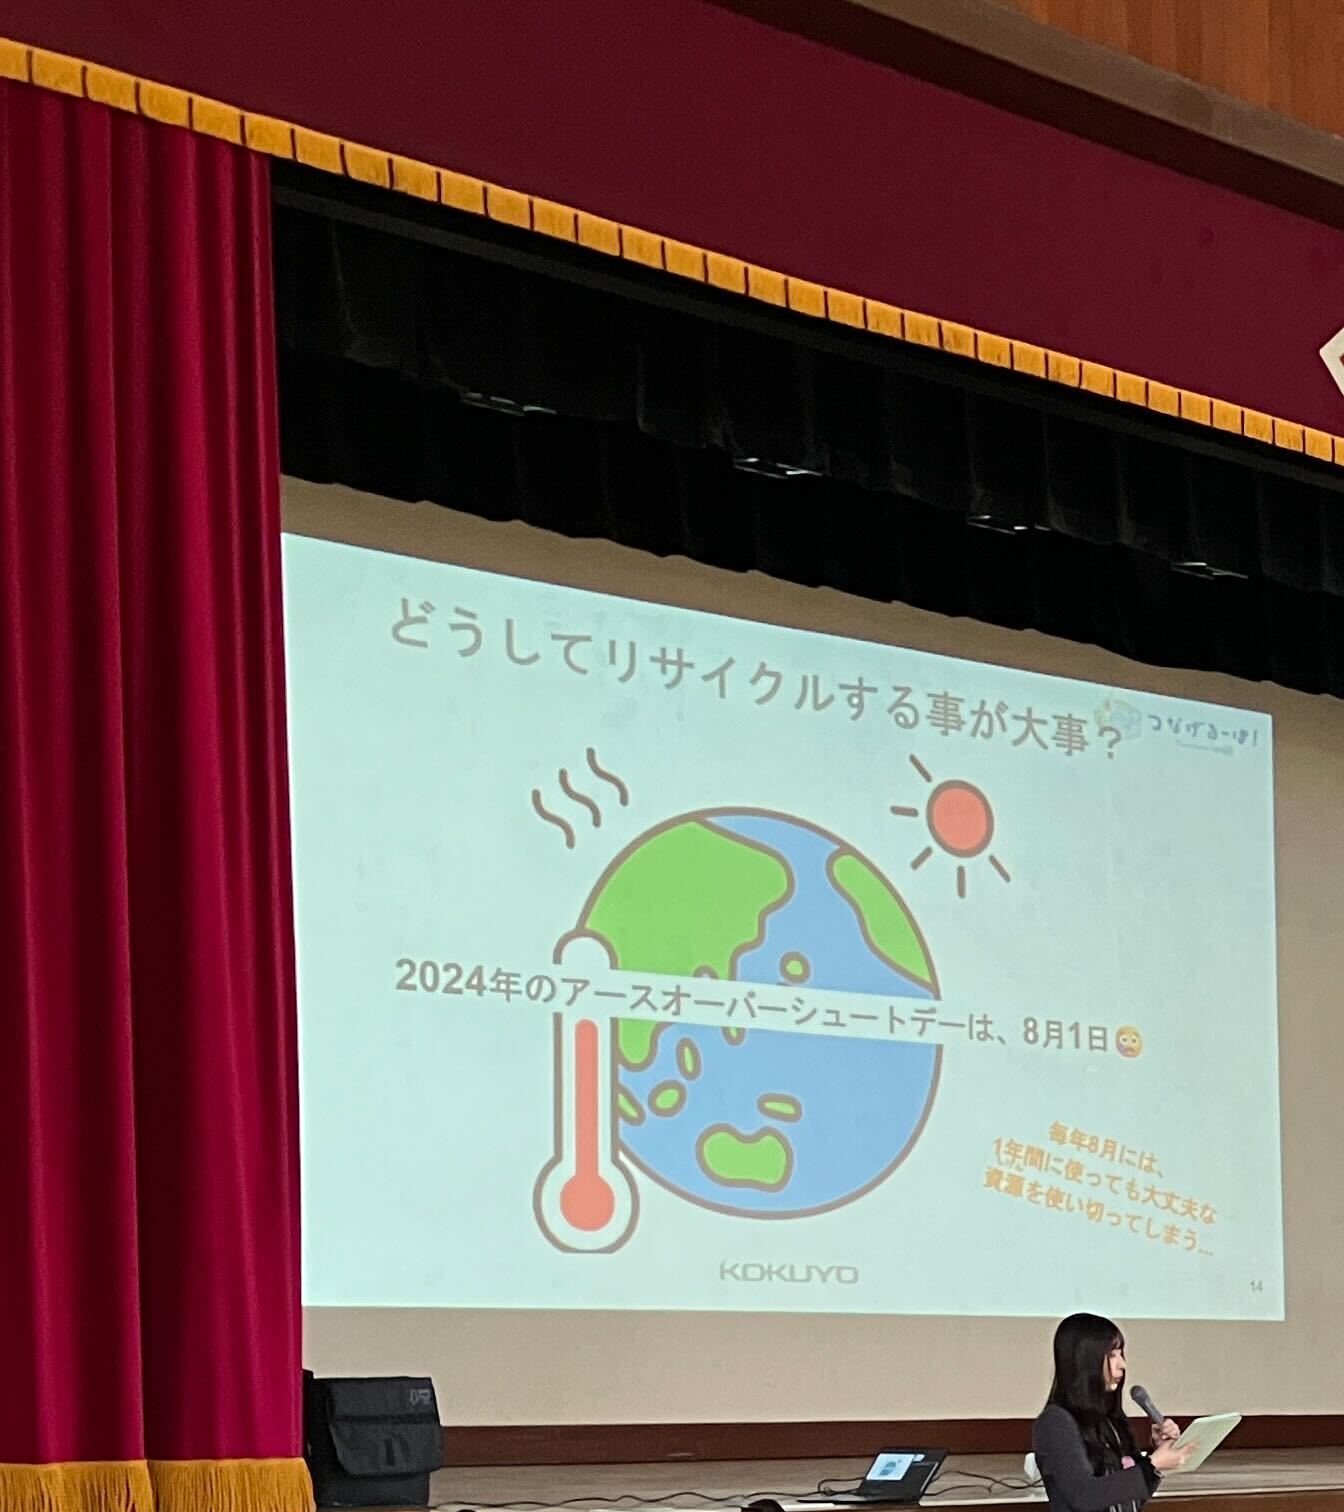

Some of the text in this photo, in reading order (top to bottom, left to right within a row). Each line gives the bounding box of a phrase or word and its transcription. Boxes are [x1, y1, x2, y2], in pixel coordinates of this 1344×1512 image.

[390, 597, 1124, 760] どうしてリサイクルする事が大事?
[394, 958, 1109, 1053] 2024年のアースオーバーシュートデーは、8月1日
[993, 1136, 1217, 1225] 1年間に使っても大丈夫な
[1048, 1120, 1164, 1178] 毎年8月には、
[719, 1260, 859, 1285] KOKUYO
[1249, 1280, 1264, 1293] 14
